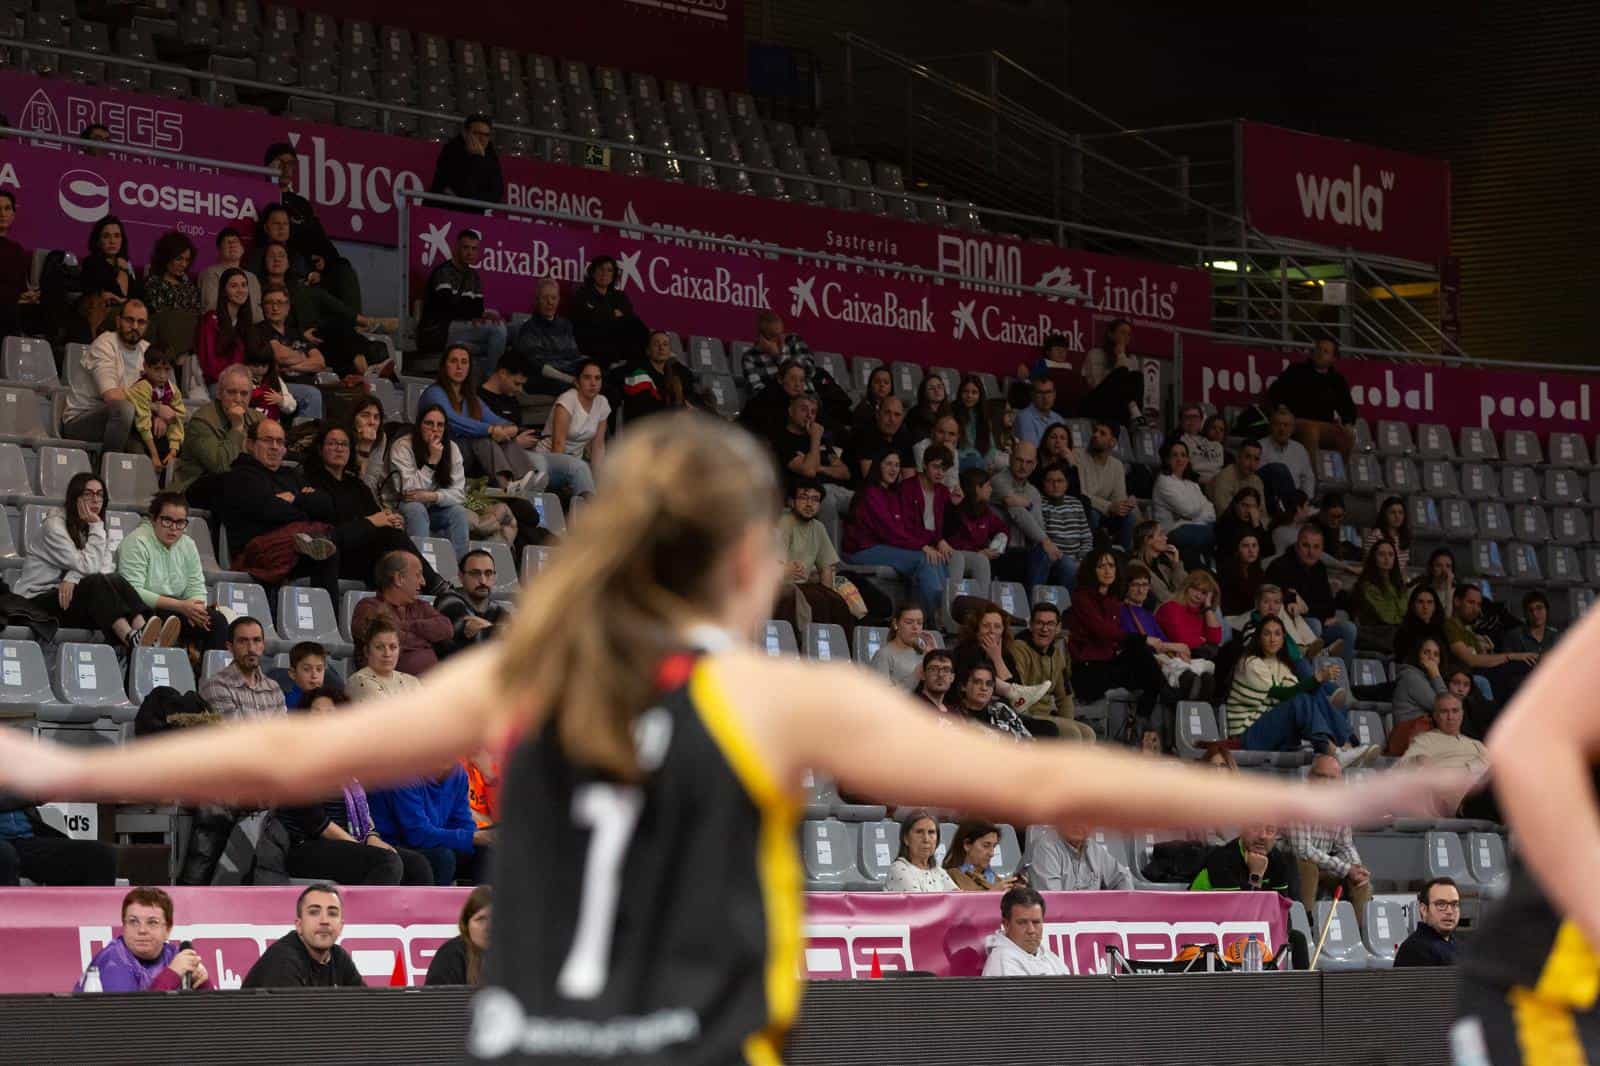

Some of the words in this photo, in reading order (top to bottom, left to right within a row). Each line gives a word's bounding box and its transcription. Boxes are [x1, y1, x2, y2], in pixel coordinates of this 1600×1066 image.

[118, 180, 260, 223] COSEHISA
[507, 182, 604, 220] BIGBANG
[1296, 163, 1384, 233] wala
[176, 220, 205, 237] Grupo
[648, 256, 772, 310] CaixaBank
[822, 282, 936, 333] CaixaBank
[1201, 354, 1291, 403] paob
[1350, 369, 1433, 411] aobal
[1480, 381, 1591, 429] paobal
